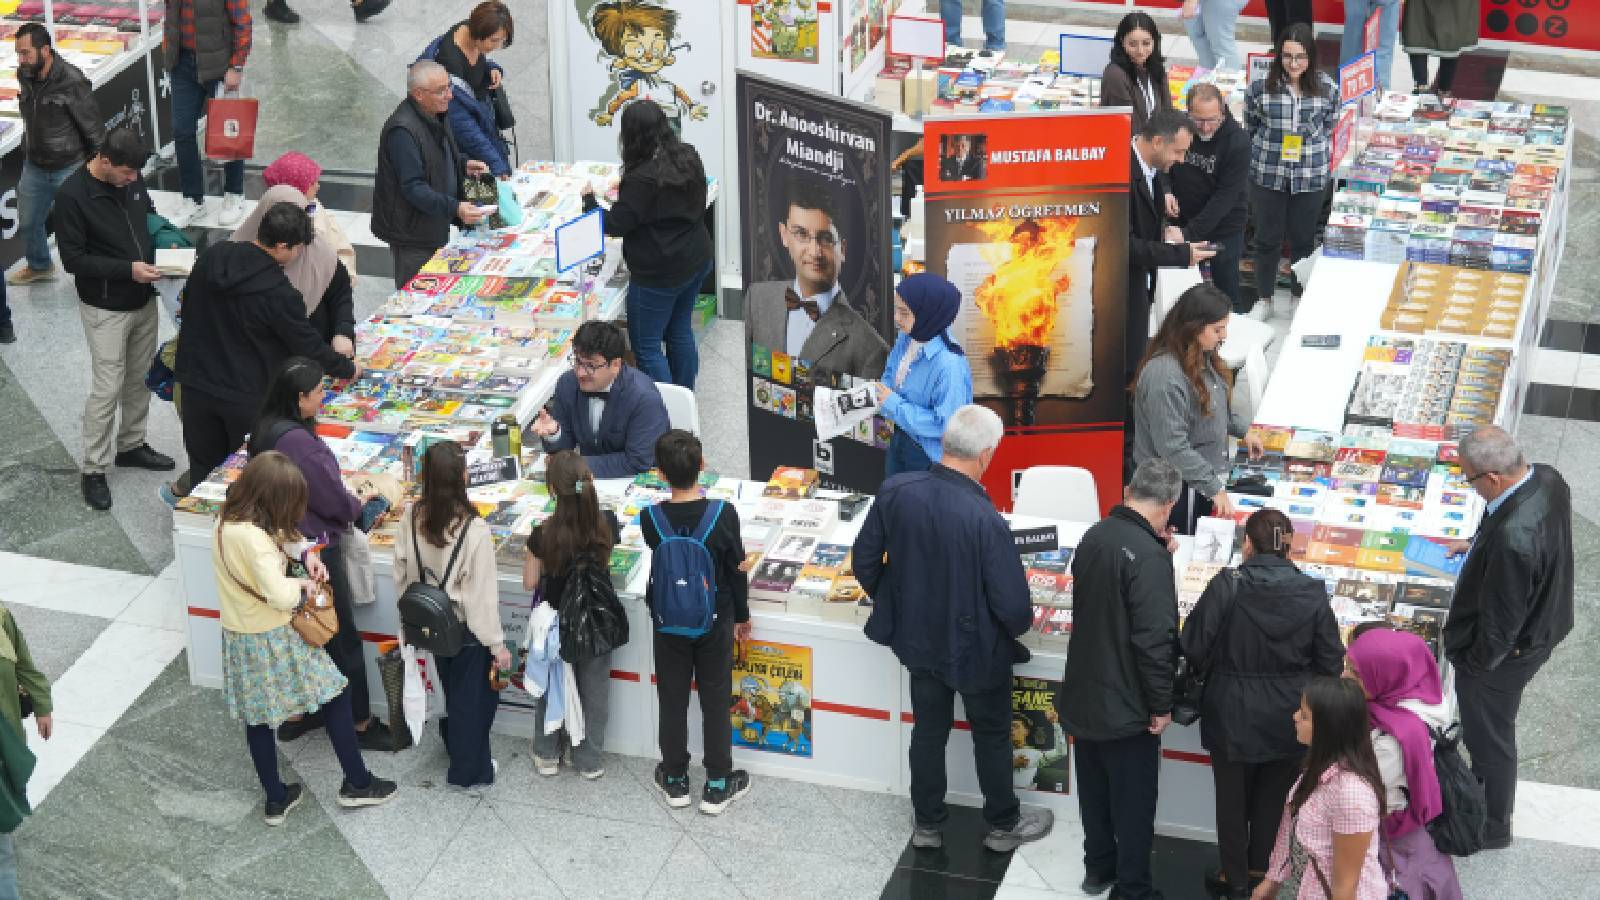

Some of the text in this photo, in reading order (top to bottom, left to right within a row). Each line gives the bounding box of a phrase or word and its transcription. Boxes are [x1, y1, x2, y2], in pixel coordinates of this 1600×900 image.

[754, 101, 876, 152] Dr. Anooshirvan
[786, 137, 843, 173] Miandji
[990, 146, 1107, 164] MUSTAFA BALBAY
[944, 206, 1006, 224] YILMAZ
